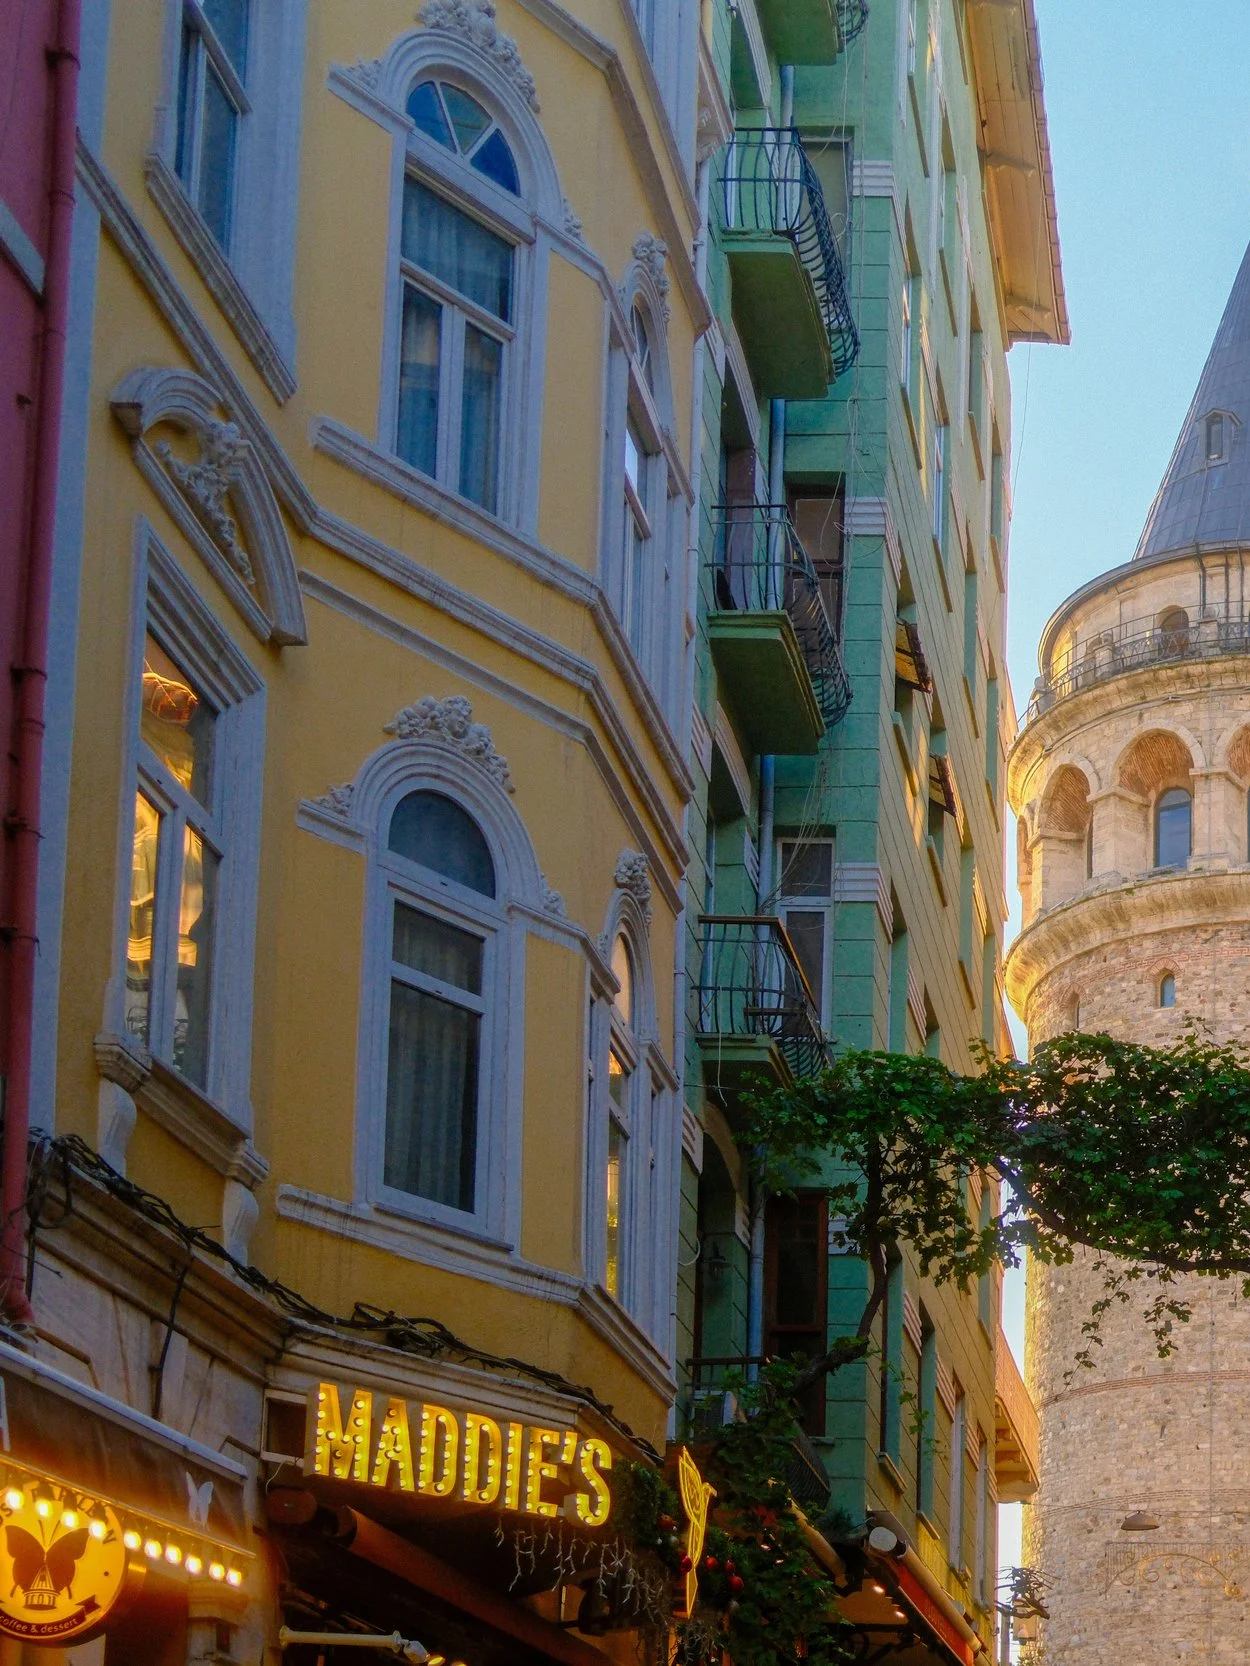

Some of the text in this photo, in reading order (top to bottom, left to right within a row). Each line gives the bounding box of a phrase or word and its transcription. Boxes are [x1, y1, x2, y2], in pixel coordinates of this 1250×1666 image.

[305, 1382, 612, 1526] MADDIE'S
[30, 1624, 39, 1633] &
[40, 1618, 78, 1634] dessert
